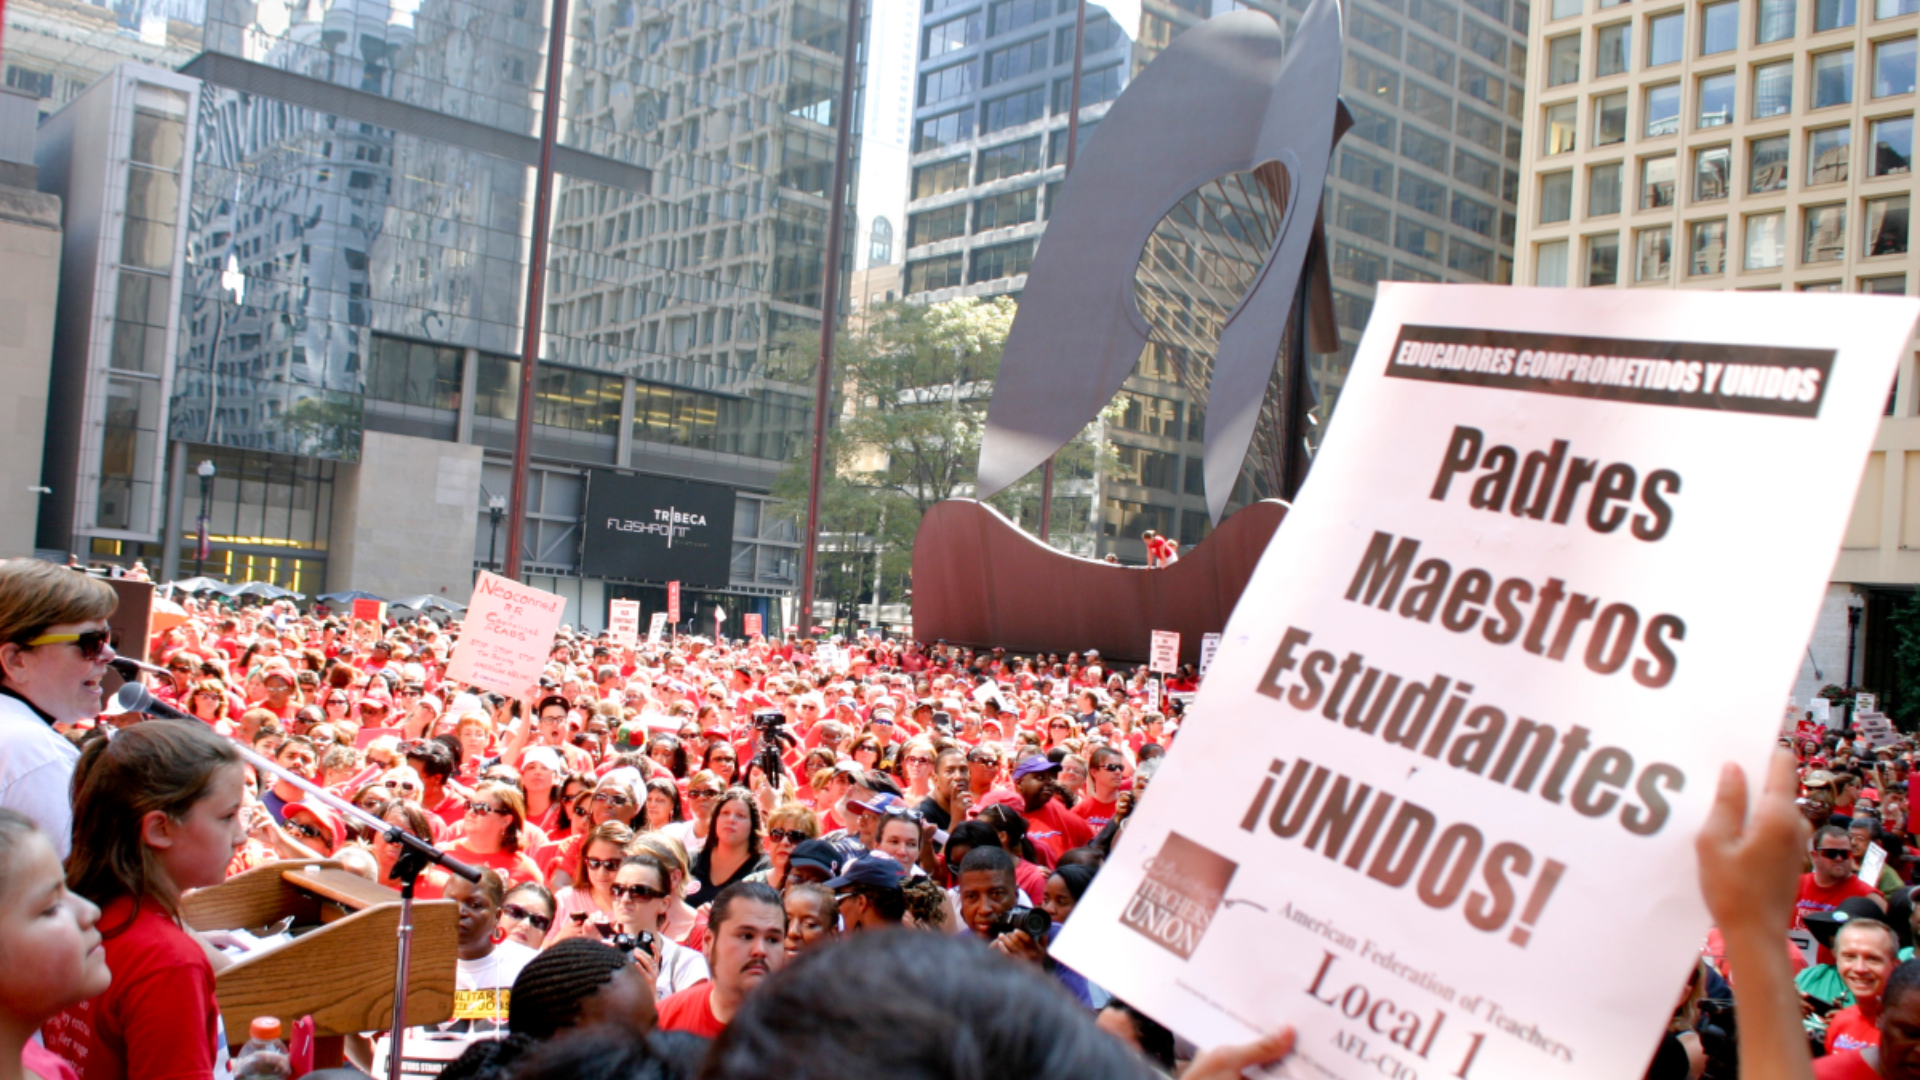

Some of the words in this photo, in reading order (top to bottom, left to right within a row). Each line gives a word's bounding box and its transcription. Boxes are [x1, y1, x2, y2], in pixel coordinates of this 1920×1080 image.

[1395, 340, 1516, 376] EDUCADORES
[1514, 350, 1704, 395] COMPROMETIDOS
[1702, 362, 1724, 394] Y
[1720, 363, 1823, 403] UNIDOS
[653, 508, 707, 527] TRIBECA
[1429, 425, 1682, 543] Padres
[479, 577, 558, 613] Neoconned
[1343, 529, 1687, 690] Maestros
[1255, 625, 1687, 838] Estudiantes
[1239, 757, 1568, 949] ¡UNIDOS!
[1124, 892, 1205, 954] UNION
[1137, 876, 1215, 930] TEACHERS
[1278, 900, 1357, 951] American
[1358, 938, 1457, 1003] Federation
[1458, 992, 1485, 1016] of
[1484, 1002, 1576, 1063] Teachers
[1303, 947, 1448, 1060] Local
[1450, 1030, 1488, 1080] 1
[1330, 1028, 1420, 1080] AFL-CIO
